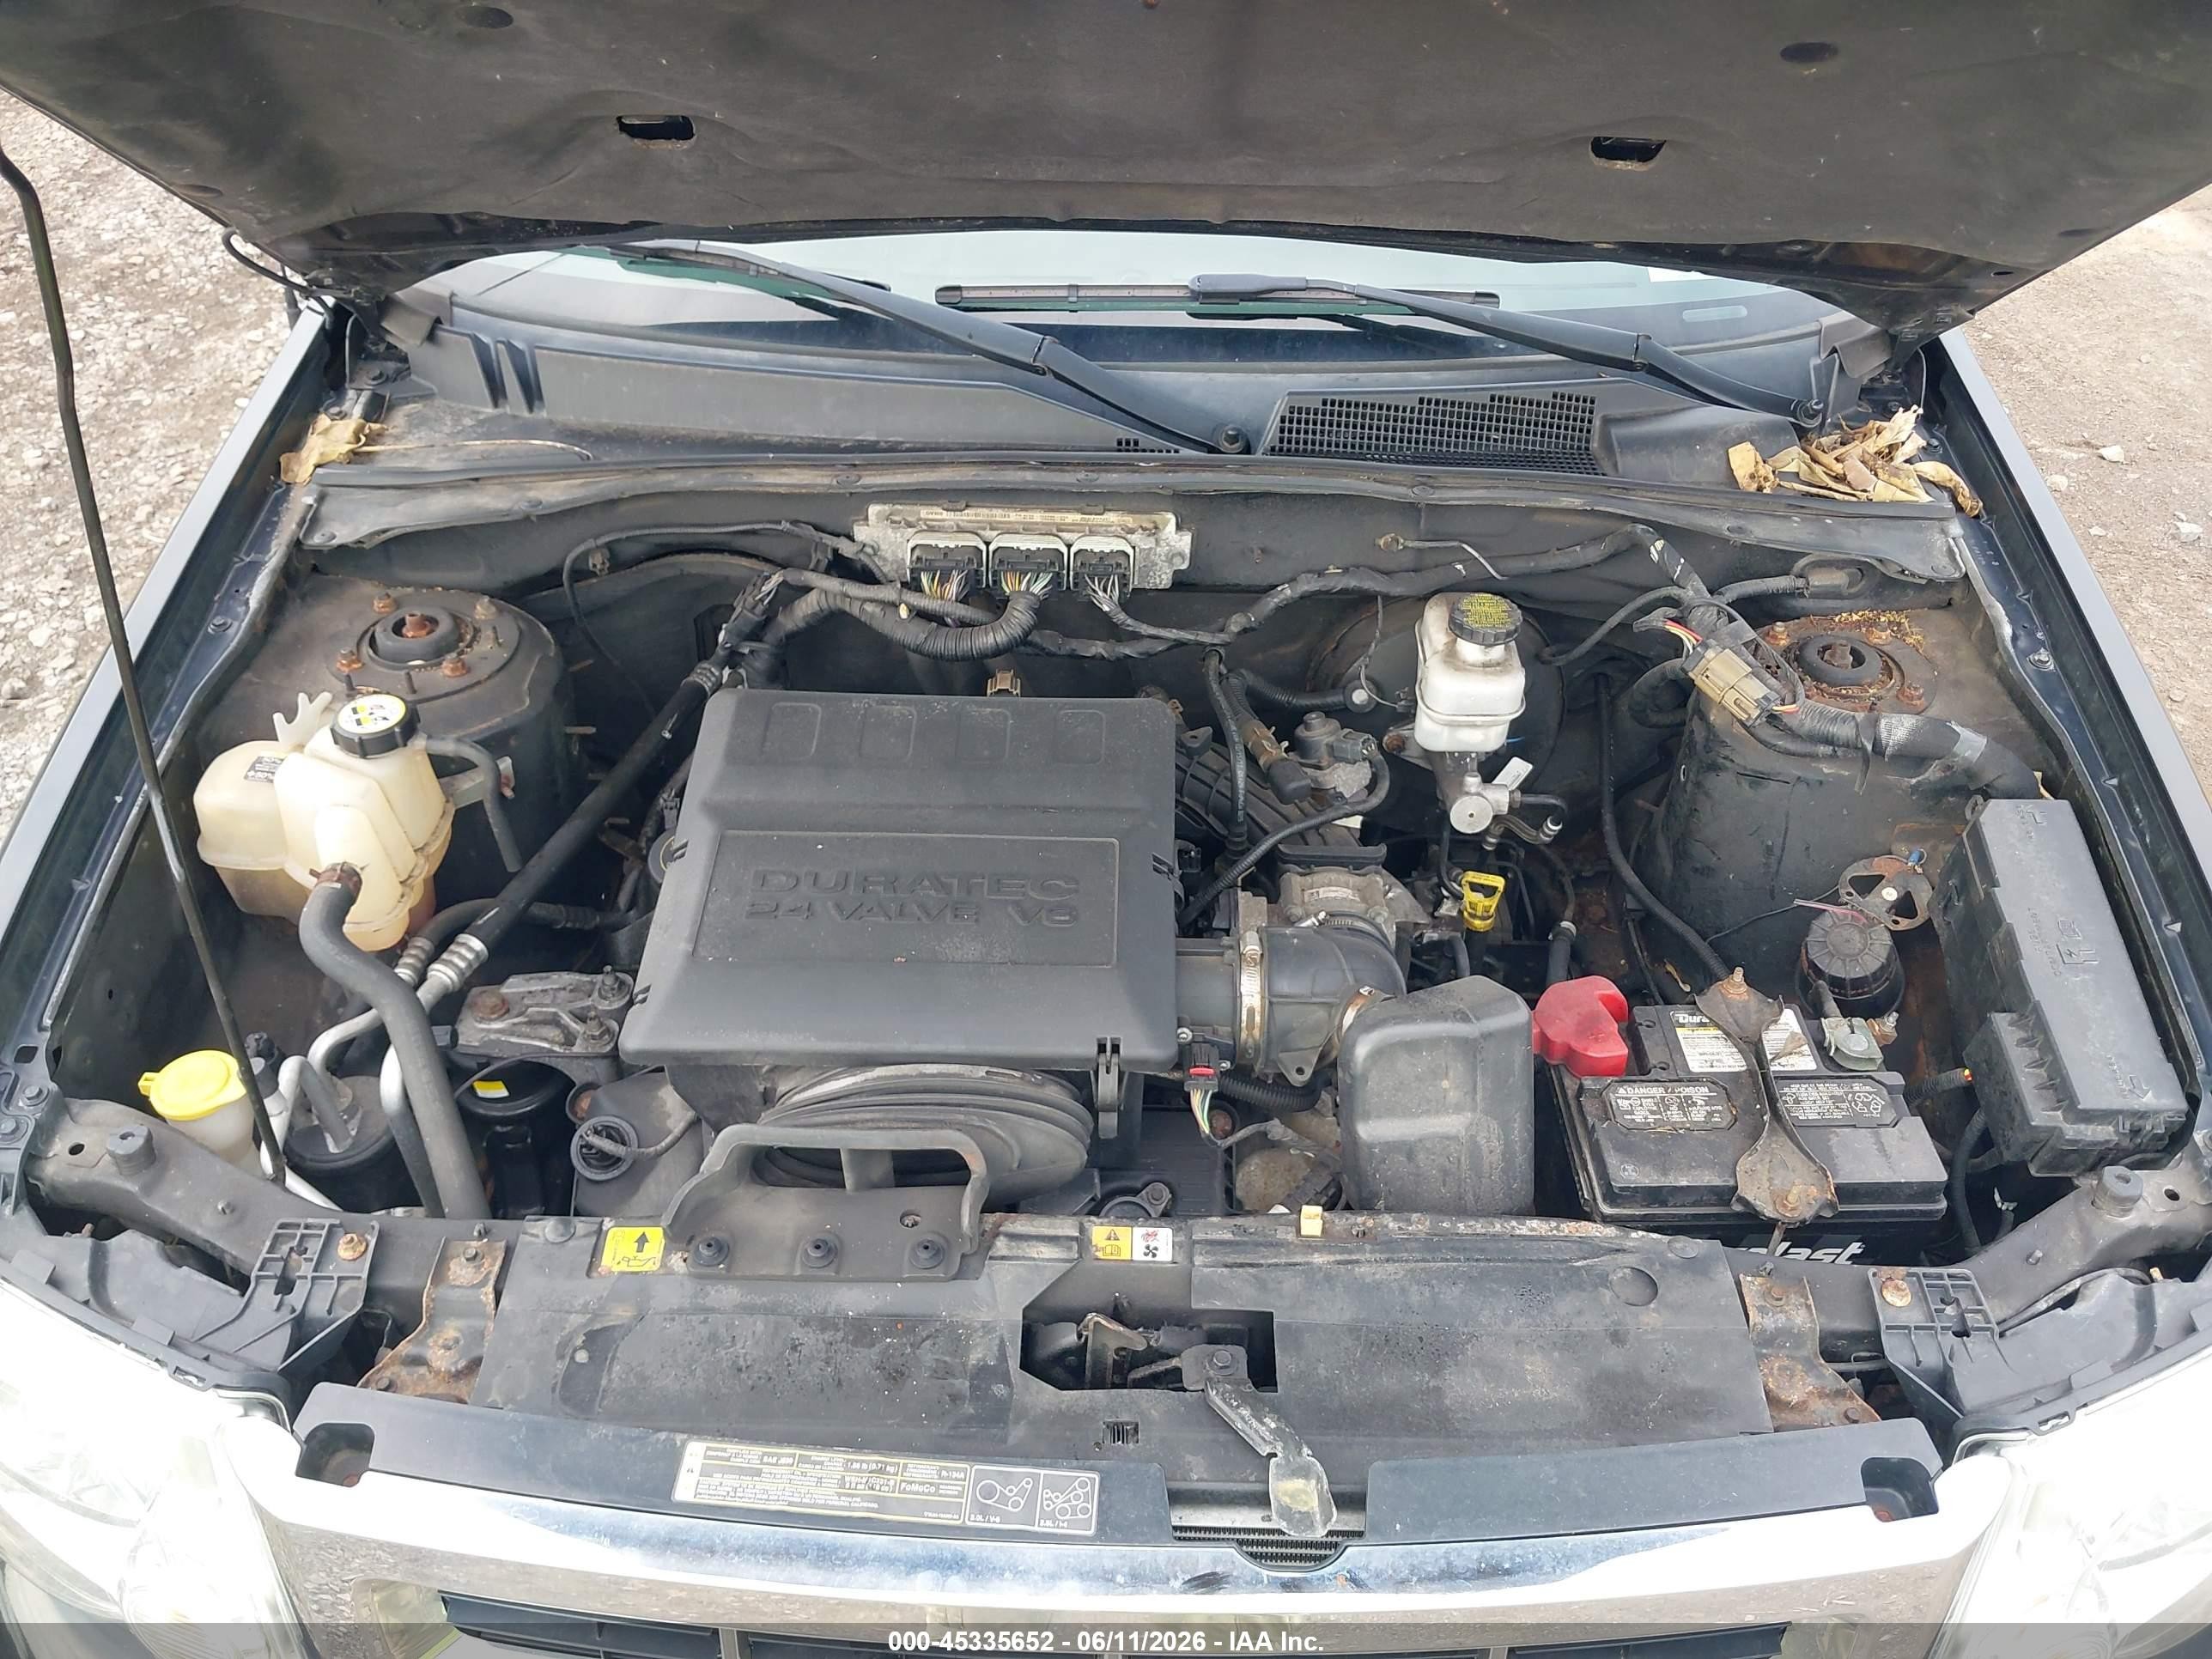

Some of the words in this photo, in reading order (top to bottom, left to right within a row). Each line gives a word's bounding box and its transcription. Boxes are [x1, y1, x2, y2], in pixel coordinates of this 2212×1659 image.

[751, 869, 1079, 900] DURATEC
[746, 901, 812, 921] 24
[830, 902, 980, 924] VALVE
[1007, 904, 1079, 927] V6
[1628, 1086, 1666, 1095] DANGER
[1735, 1241, 1863, 1265] last
[899, 1482, 936, 1493] FoMoCo
